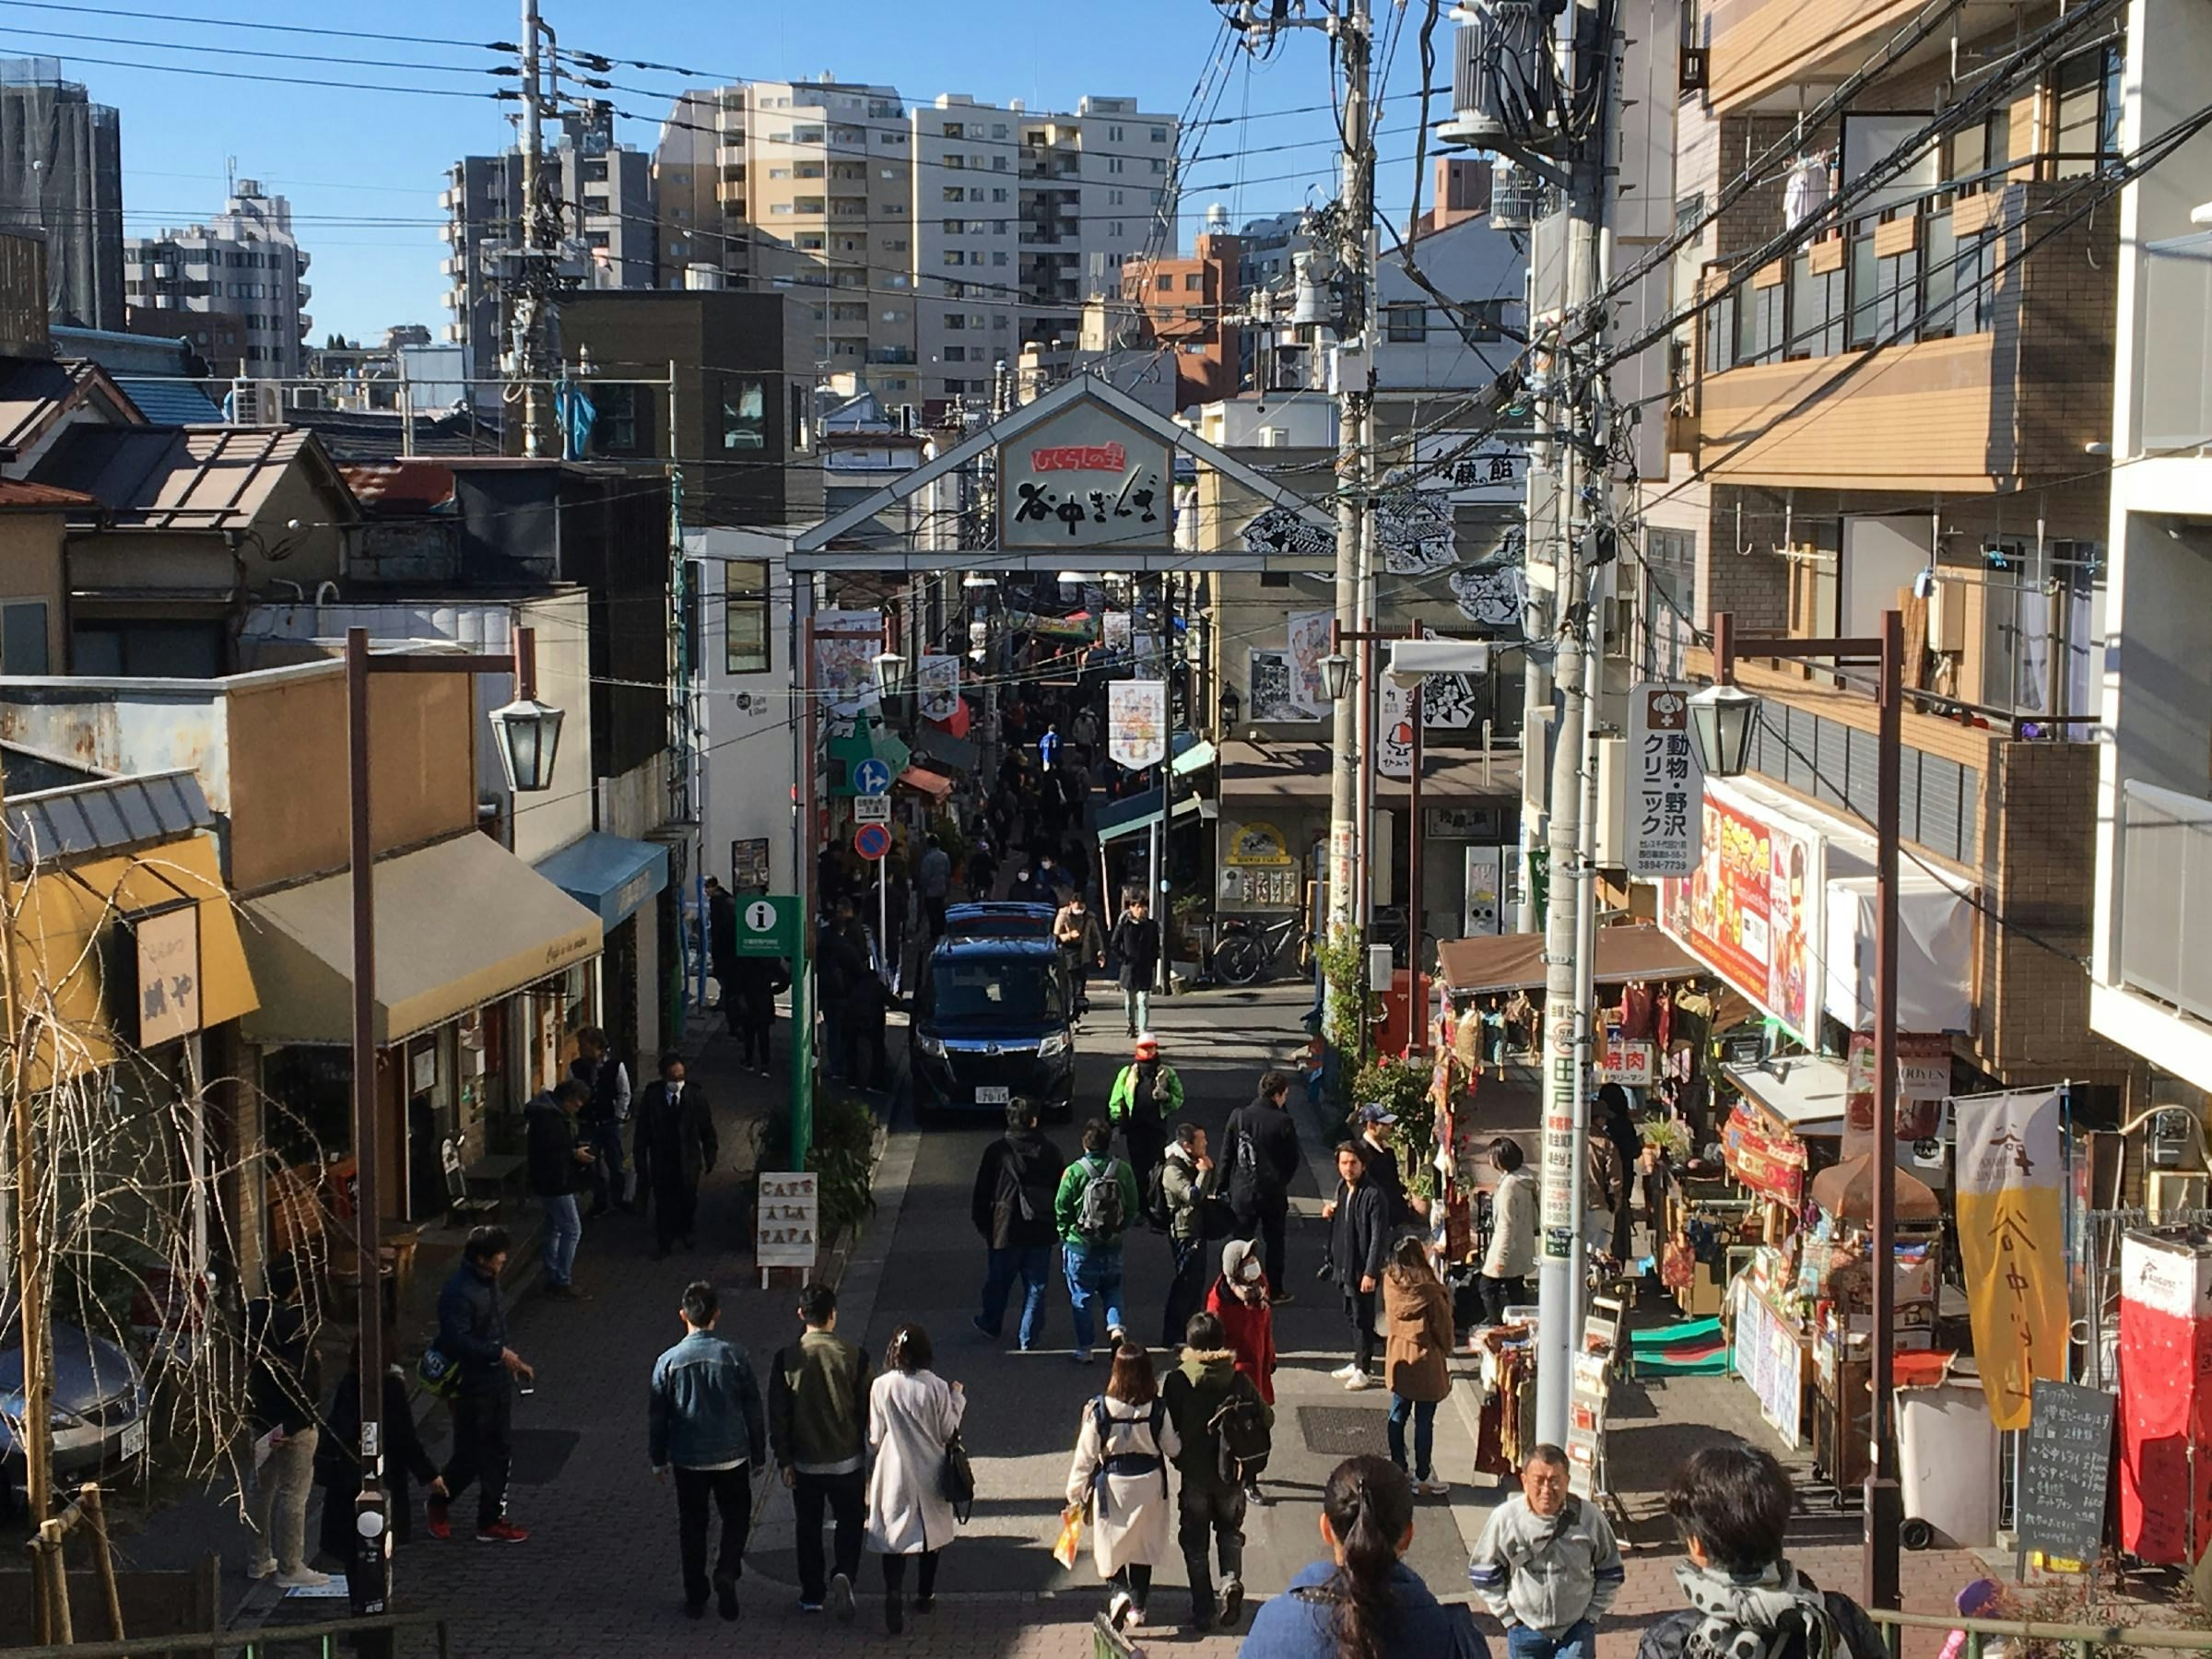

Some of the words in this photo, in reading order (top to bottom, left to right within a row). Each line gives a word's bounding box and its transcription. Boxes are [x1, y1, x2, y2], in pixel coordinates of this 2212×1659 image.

[1033, 442, 1124, 471] ひぐらしの里
[1015, 465, 1158, 535] 谷中ぎんざ
[1641, 735, 1663, 835] クリニック
[1664, 735, 1688, 837] 動物・野沢
[760, 1228, 813, 1244] PAPA
